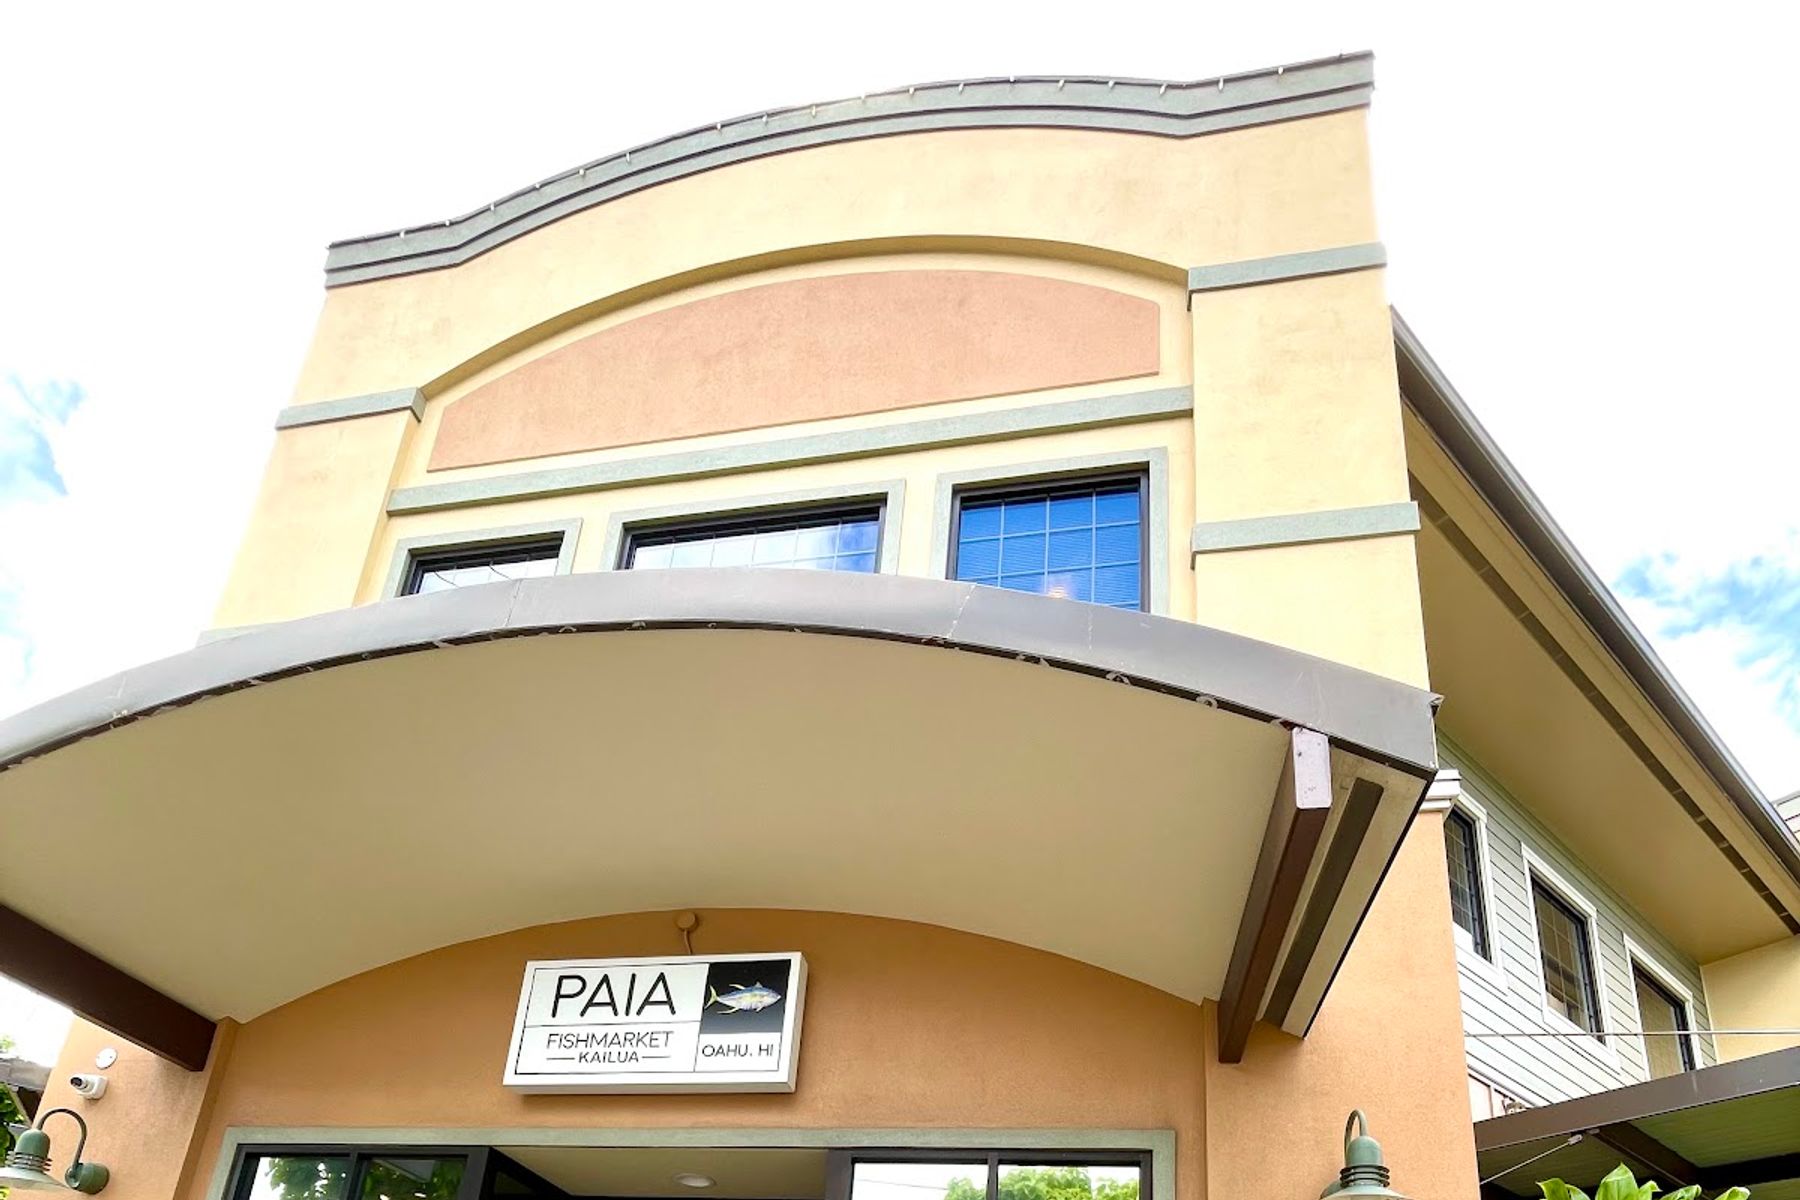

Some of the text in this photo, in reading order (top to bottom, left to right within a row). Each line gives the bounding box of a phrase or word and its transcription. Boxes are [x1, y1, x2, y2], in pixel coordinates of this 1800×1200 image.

[551, 971, 676, 1018] PAIA
[546, 1031, 674, 1049] FISHMARKET
[578, 1051, 639, 1064] KAILUA
[758, 1044, 774, 1057] HI
